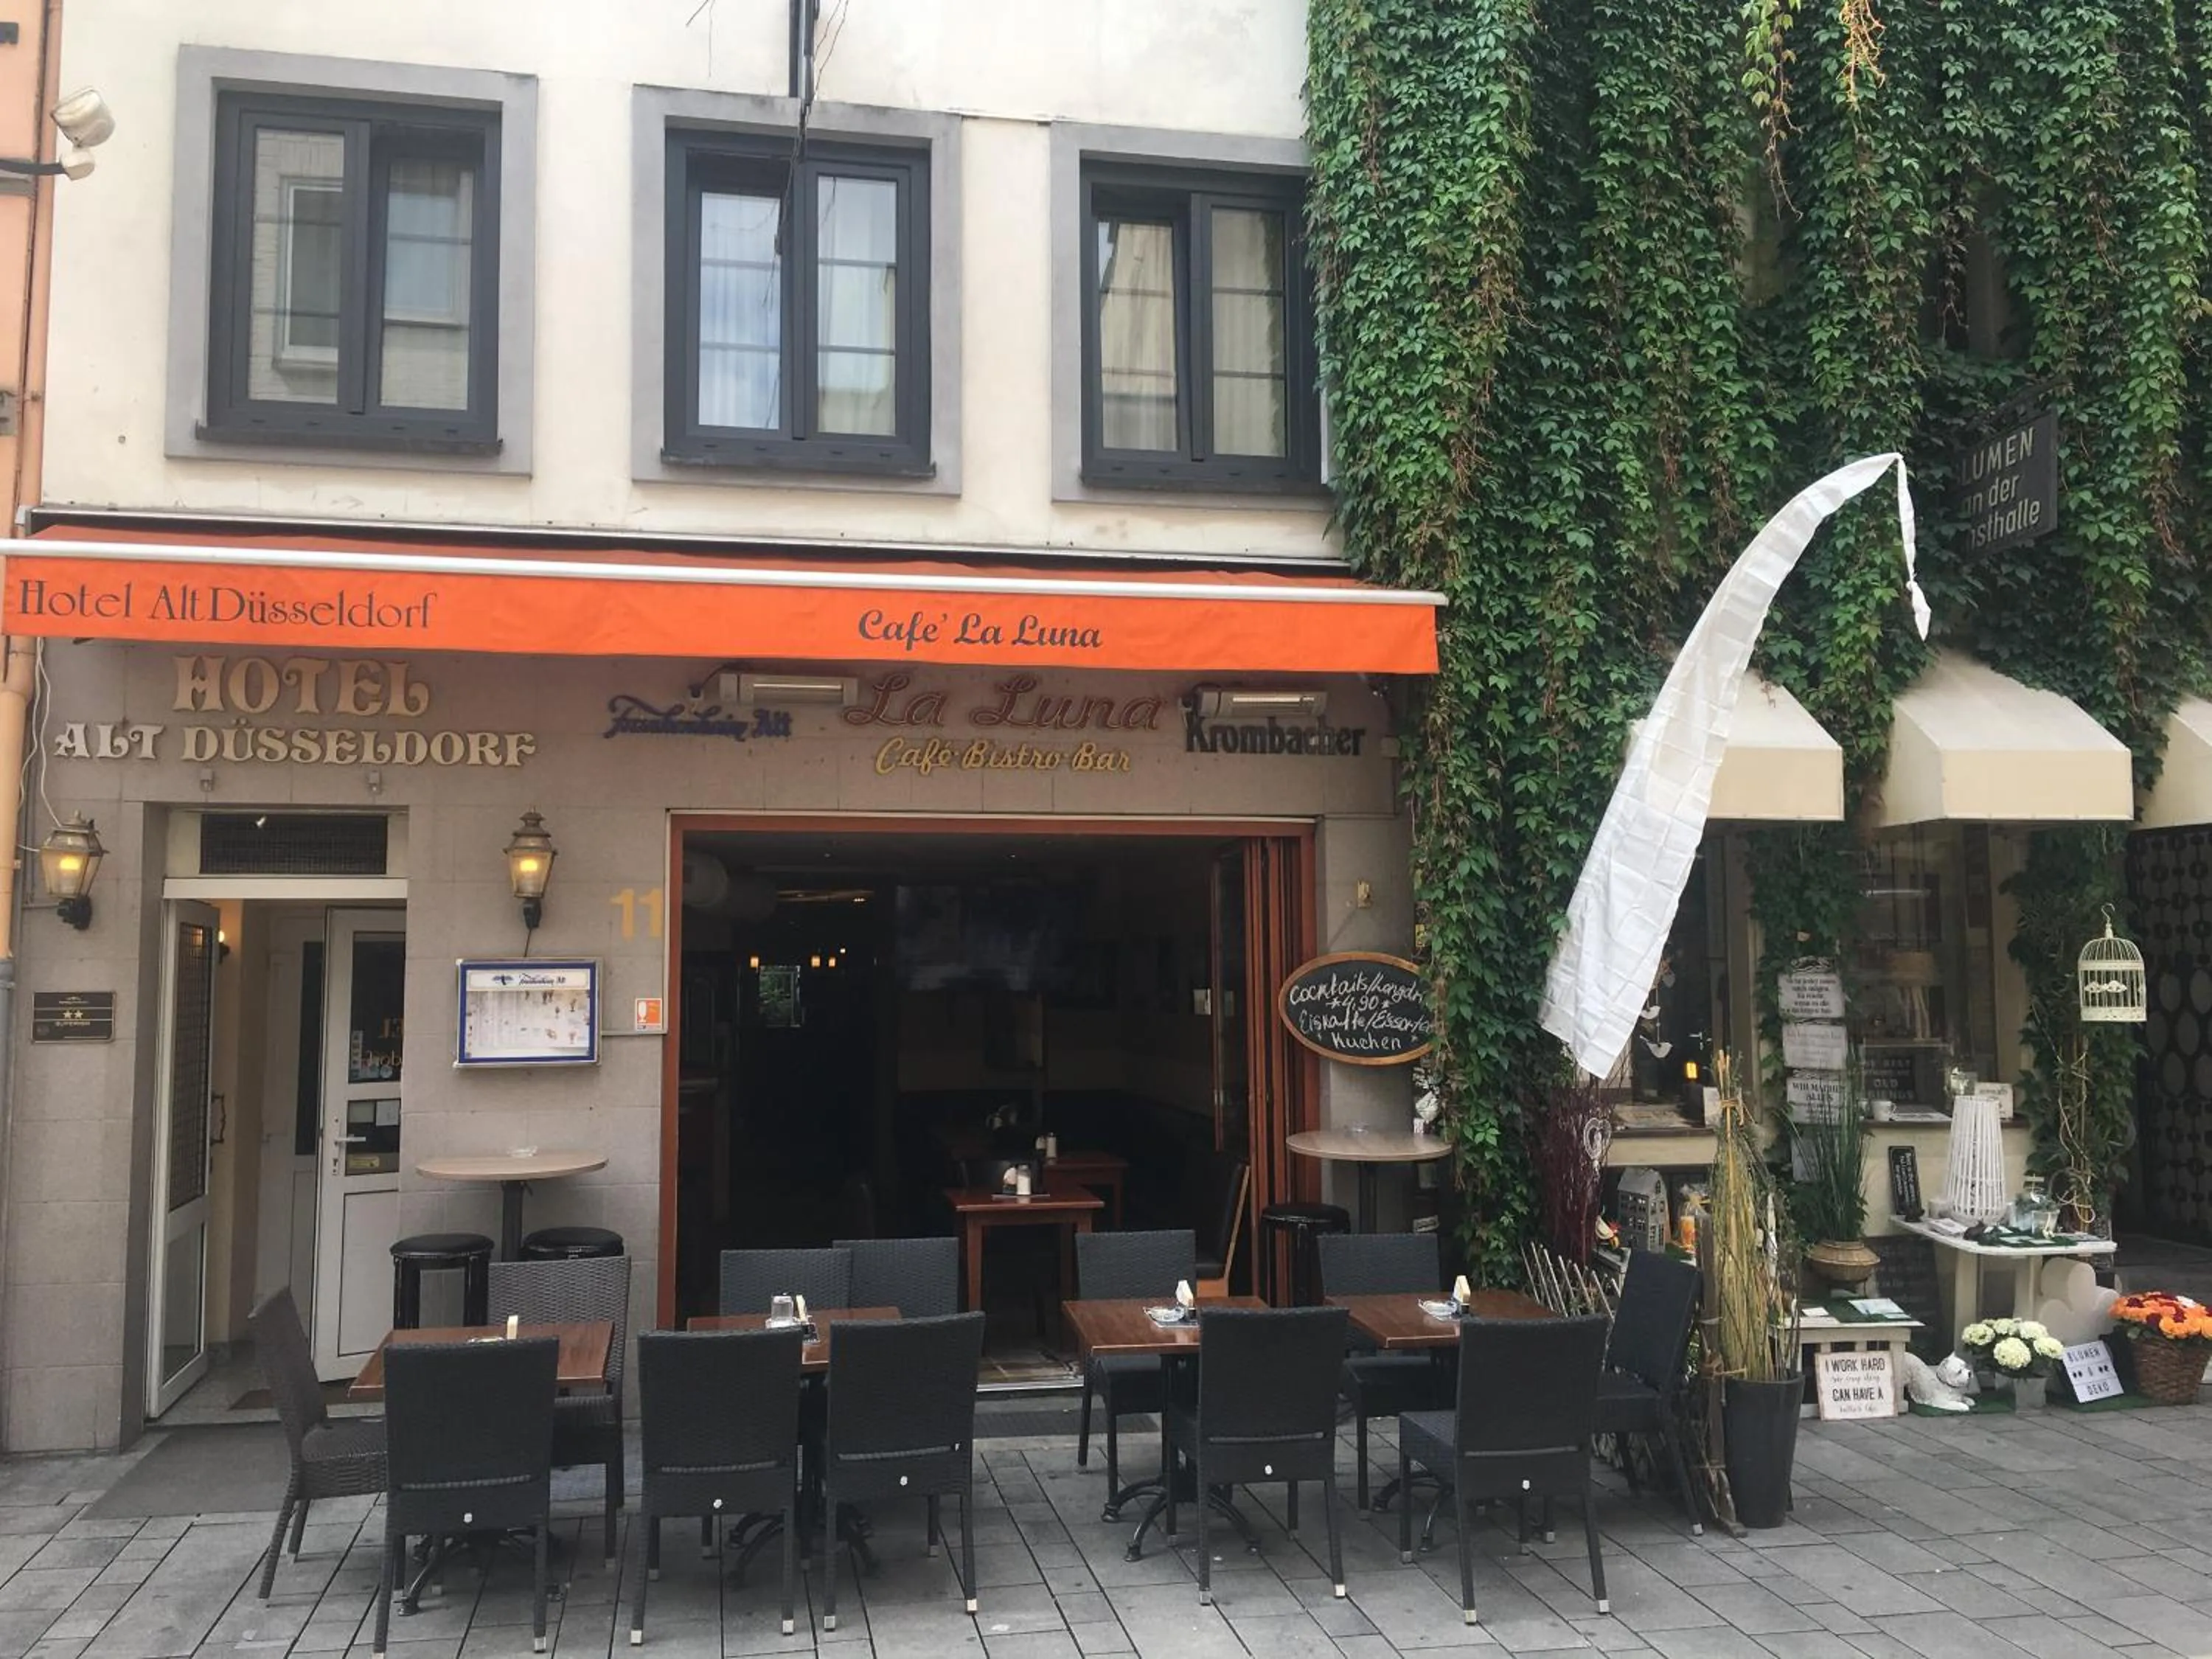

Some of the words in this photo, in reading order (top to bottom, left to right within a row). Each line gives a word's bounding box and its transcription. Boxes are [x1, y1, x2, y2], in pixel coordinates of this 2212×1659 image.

[1961, 427, 2034, 486] LUMEN
[1989, 476, 2020, 507] der
[18, 579, 134, 619] Hotel
[953, 613, 1004, 644] La
[1011, 614, 1103, 648] Luna
[171, 655, 431, 717] HOTEL
[843, 672, 948, 727] La
[969, 675, 1168, 731] Luna
[54, 722, 164, 760] ALT
[181, 718, 538, 768] DÜSSELDORF
[1185, 709, 1366, 757] Krombacher
[611, 887, 662, 940] 11
[1331, 1032, 1402, 1051] Kuchen
[1831, 1358, 1859, 1372] WORK
[1860, 1357, 1885, 1371] HARD
[1832, 1388, 1851, 1402] CAN
[1853, 1387, 1875, 1401] HAVE
